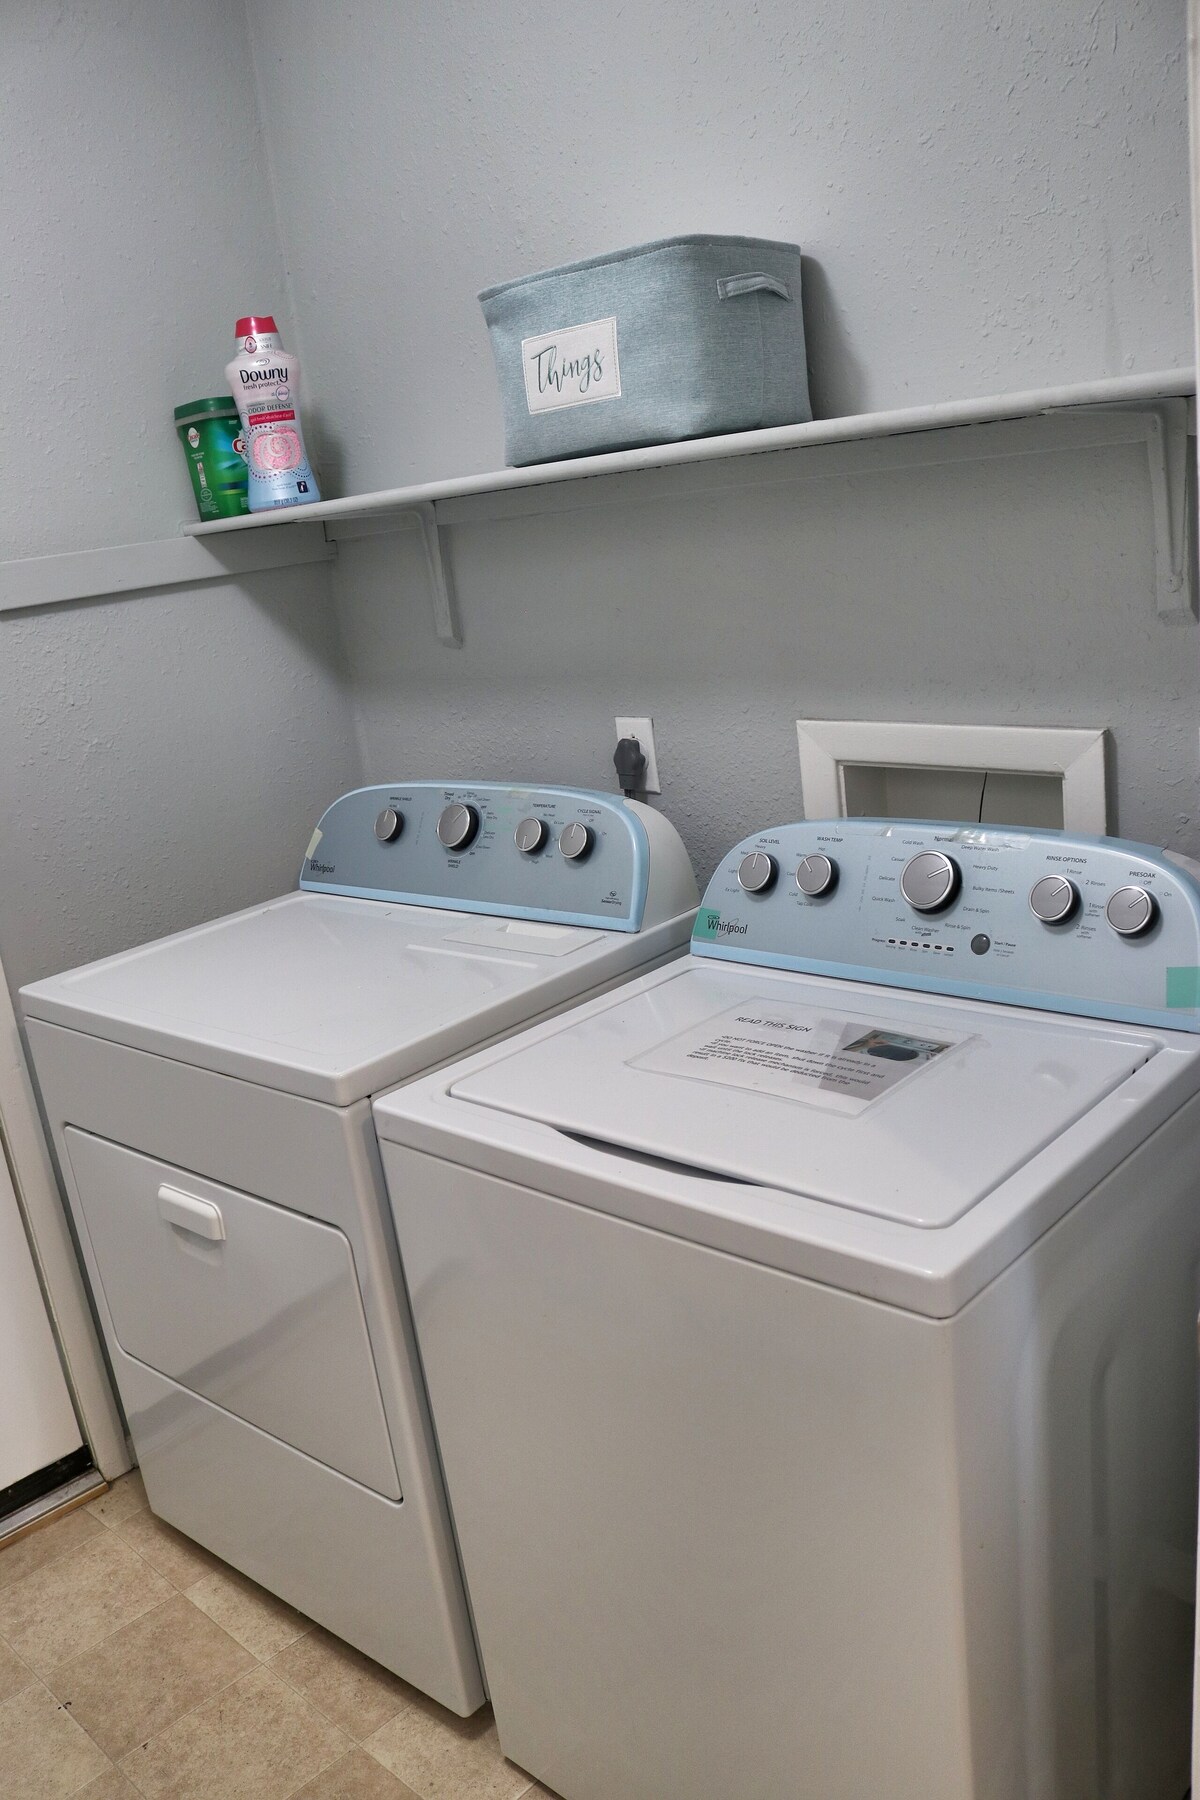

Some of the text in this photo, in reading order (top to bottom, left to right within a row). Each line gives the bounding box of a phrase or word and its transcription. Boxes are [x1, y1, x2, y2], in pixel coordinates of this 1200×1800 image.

[240, 368, 288, 383] Downy
[531, 346, 605, 393] Things
[310, 864, 335, 874] Whirlpool
[1129, 870, 1156, 878] PRESOAK
[708, 919, 748, 935] Whirlpool
[786, 1024, 812, 1032] SIGN
